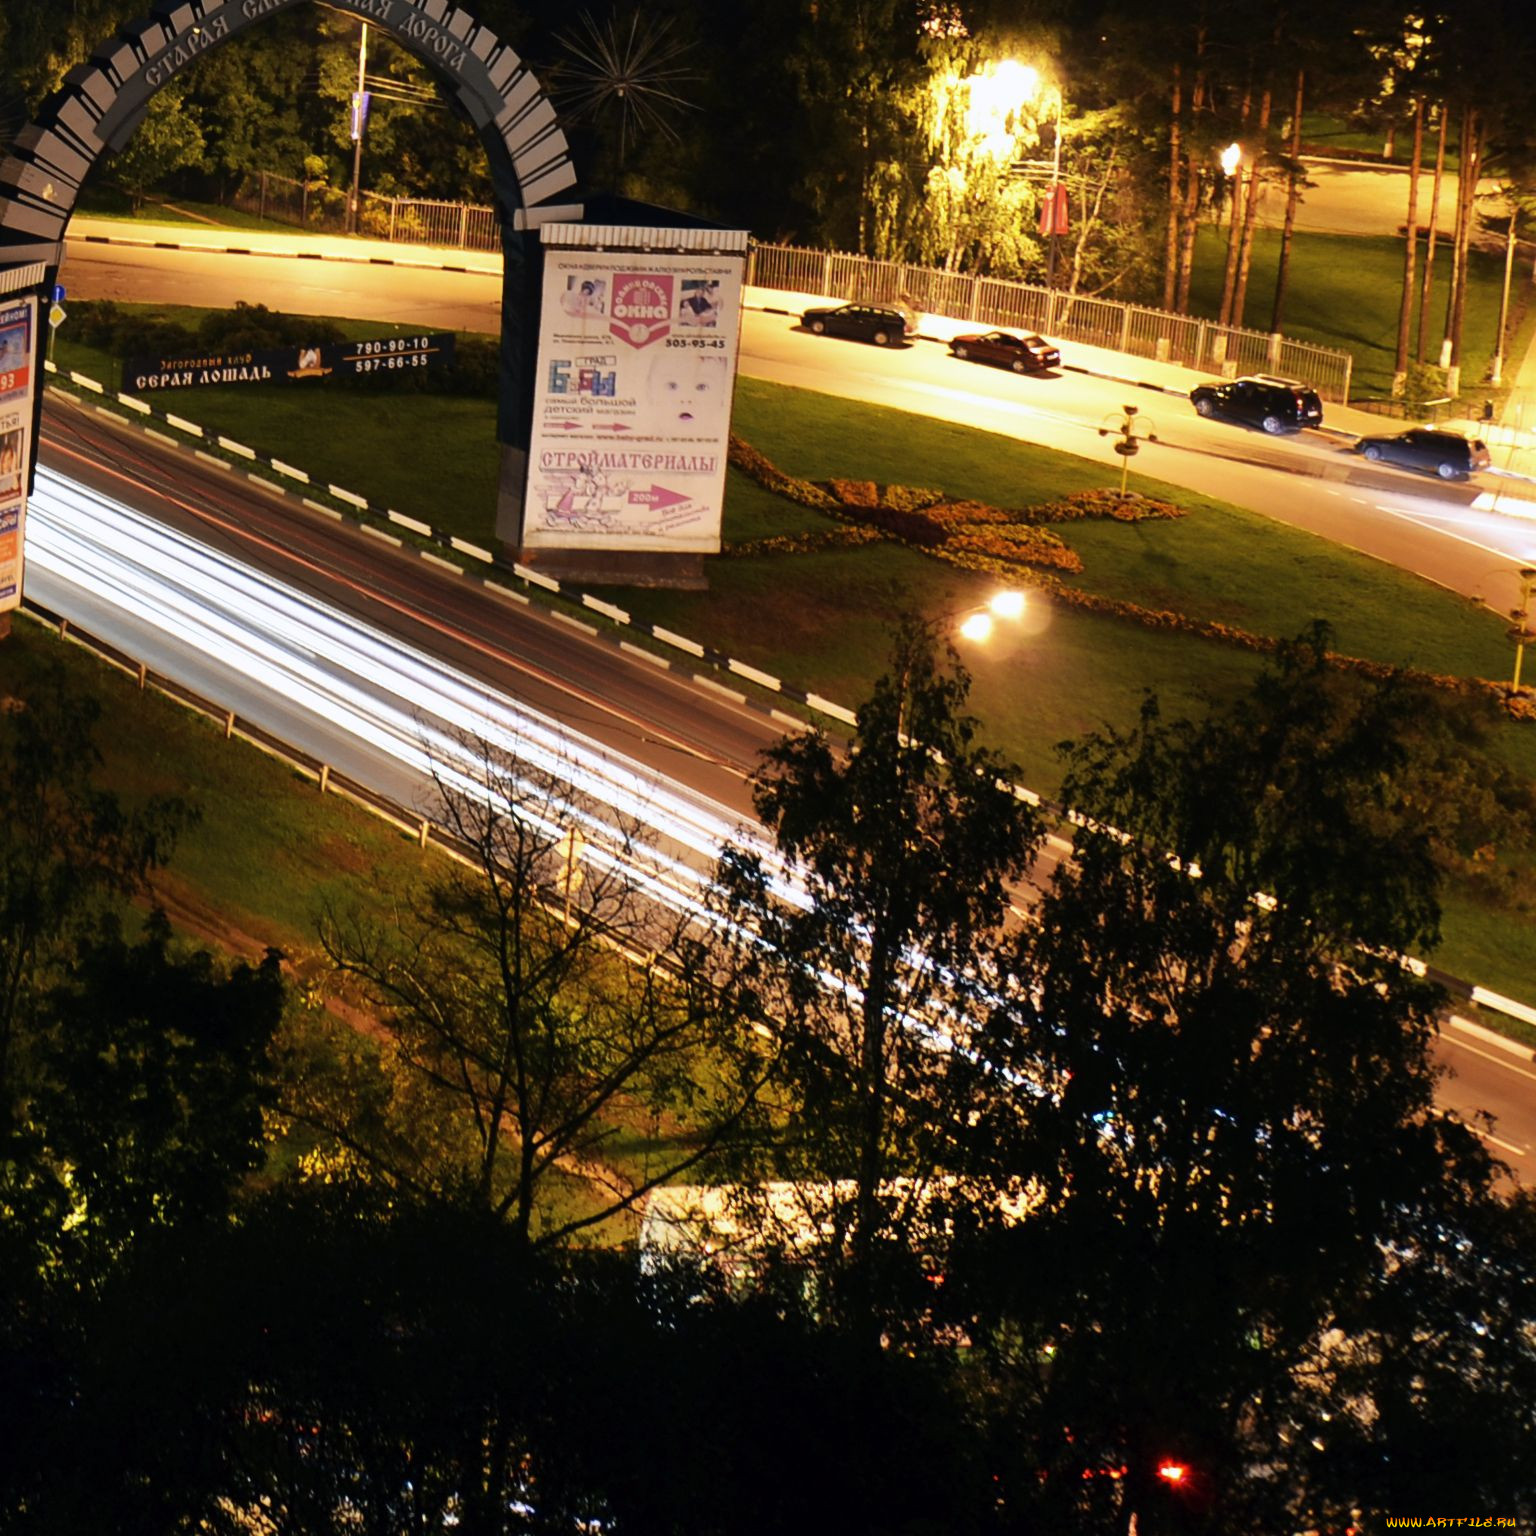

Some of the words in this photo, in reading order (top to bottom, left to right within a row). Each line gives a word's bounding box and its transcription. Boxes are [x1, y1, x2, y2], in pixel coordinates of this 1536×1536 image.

[144, 13, 231, 88] СТАРАЯ
[399, 10, 470, 72] ДОРОГА
[356, 337, 429, 356] 790-90-10
[136, 372, 193, 390] СЕРАЯ
[199, 365, 272, 386] ЛОШАДЬ
[542, 451, 717, 472] СТРОЙМАТЕРИАЛЫ
